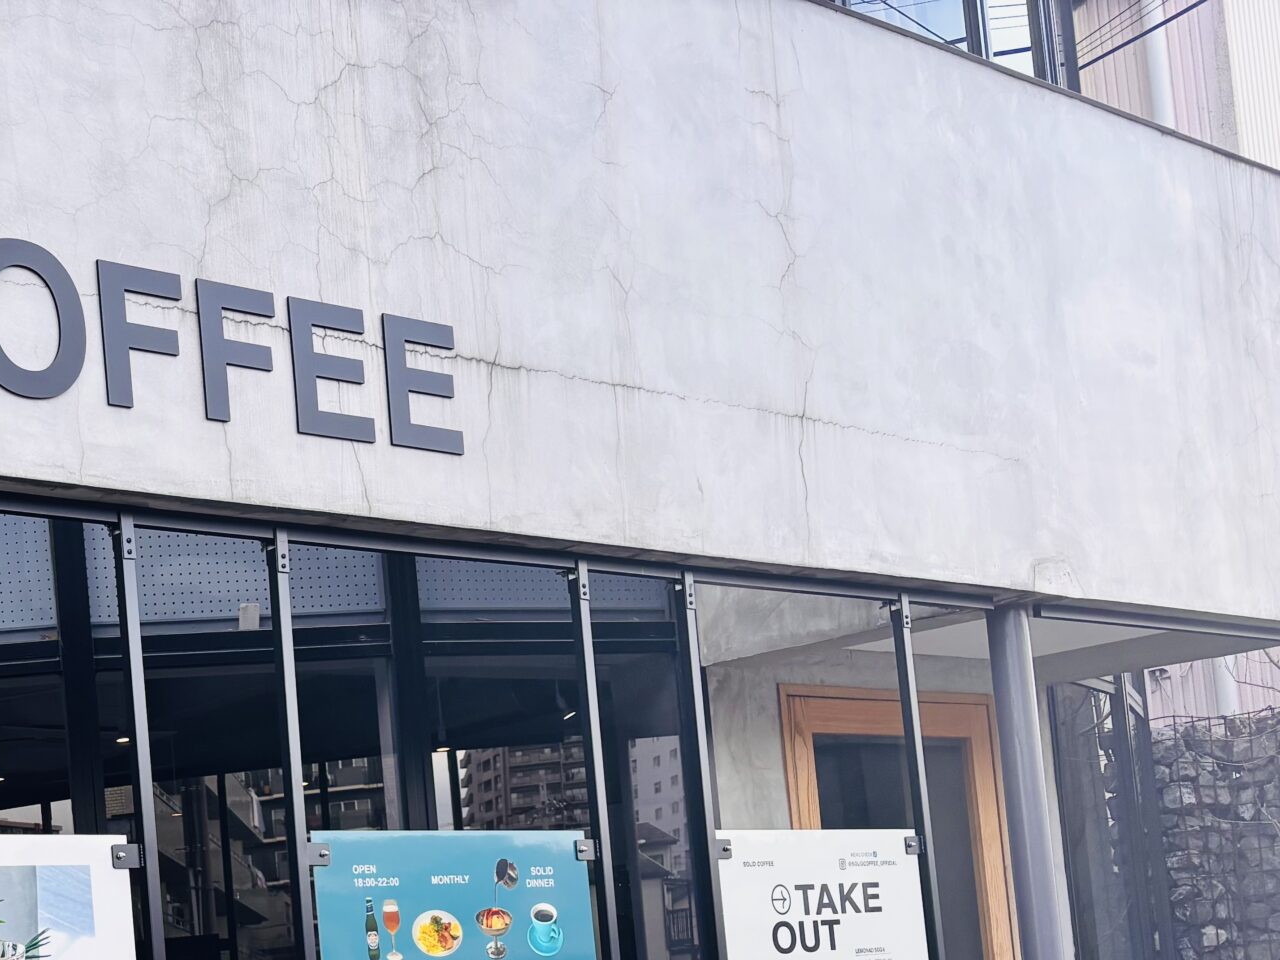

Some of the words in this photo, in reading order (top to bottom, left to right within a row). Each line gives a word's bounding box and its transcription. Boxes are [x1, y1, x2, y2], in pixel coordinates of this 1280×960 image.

[352, 864, 377, 875] OPEN
[743, 860, 757, 868] SOLID
[530, 866, 554, 876] SOLID
[353, 877, 400, 888] 18:00-22:00
[431, 874, 470, 886] MONTHLY
[526, 878, 555, 889] DINNER
[794, 881, 883, 916] TAKE
[772, 918, 841, 955] OUT
